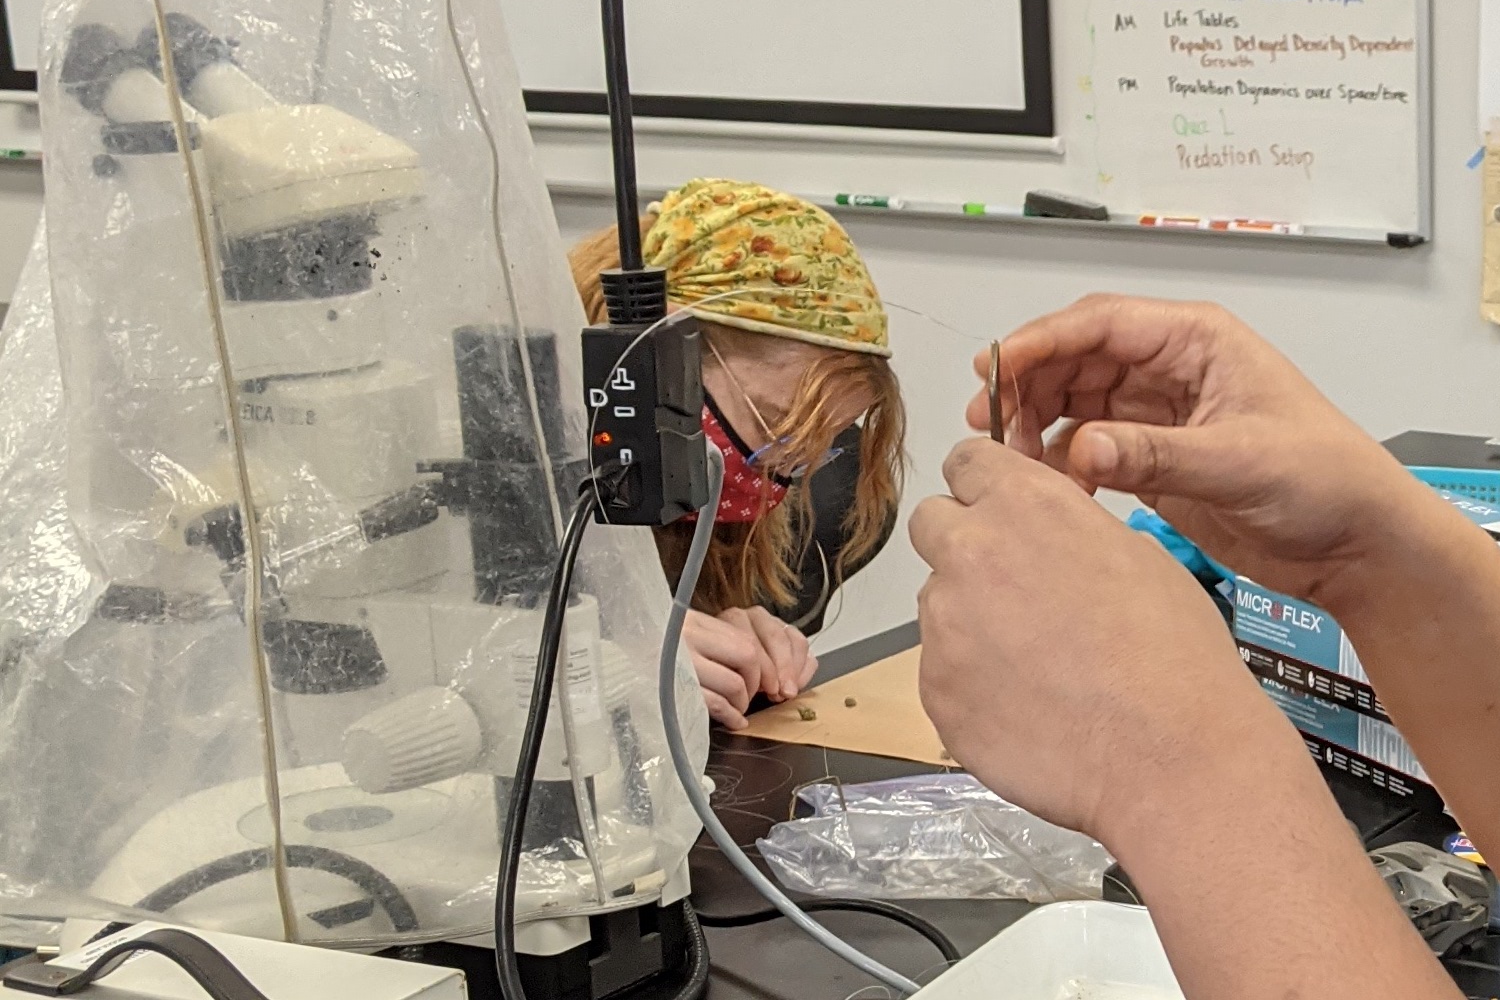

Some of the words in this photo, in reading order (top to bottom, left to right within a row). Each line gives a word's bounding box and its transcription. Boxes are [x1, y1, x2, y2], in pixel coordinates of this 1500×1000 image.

[1163, 9, 1189, 29] Life
[1192, 8, 1240, 29] Tables
[1167, 74, 1235, 99] Population
[1235, 78, 1300, 106] Dynamics
[1304, 87, 1333, 100] over
[1176, 143, 1262, 170] Predation
[1269, 143, 1316, 181] Setup
